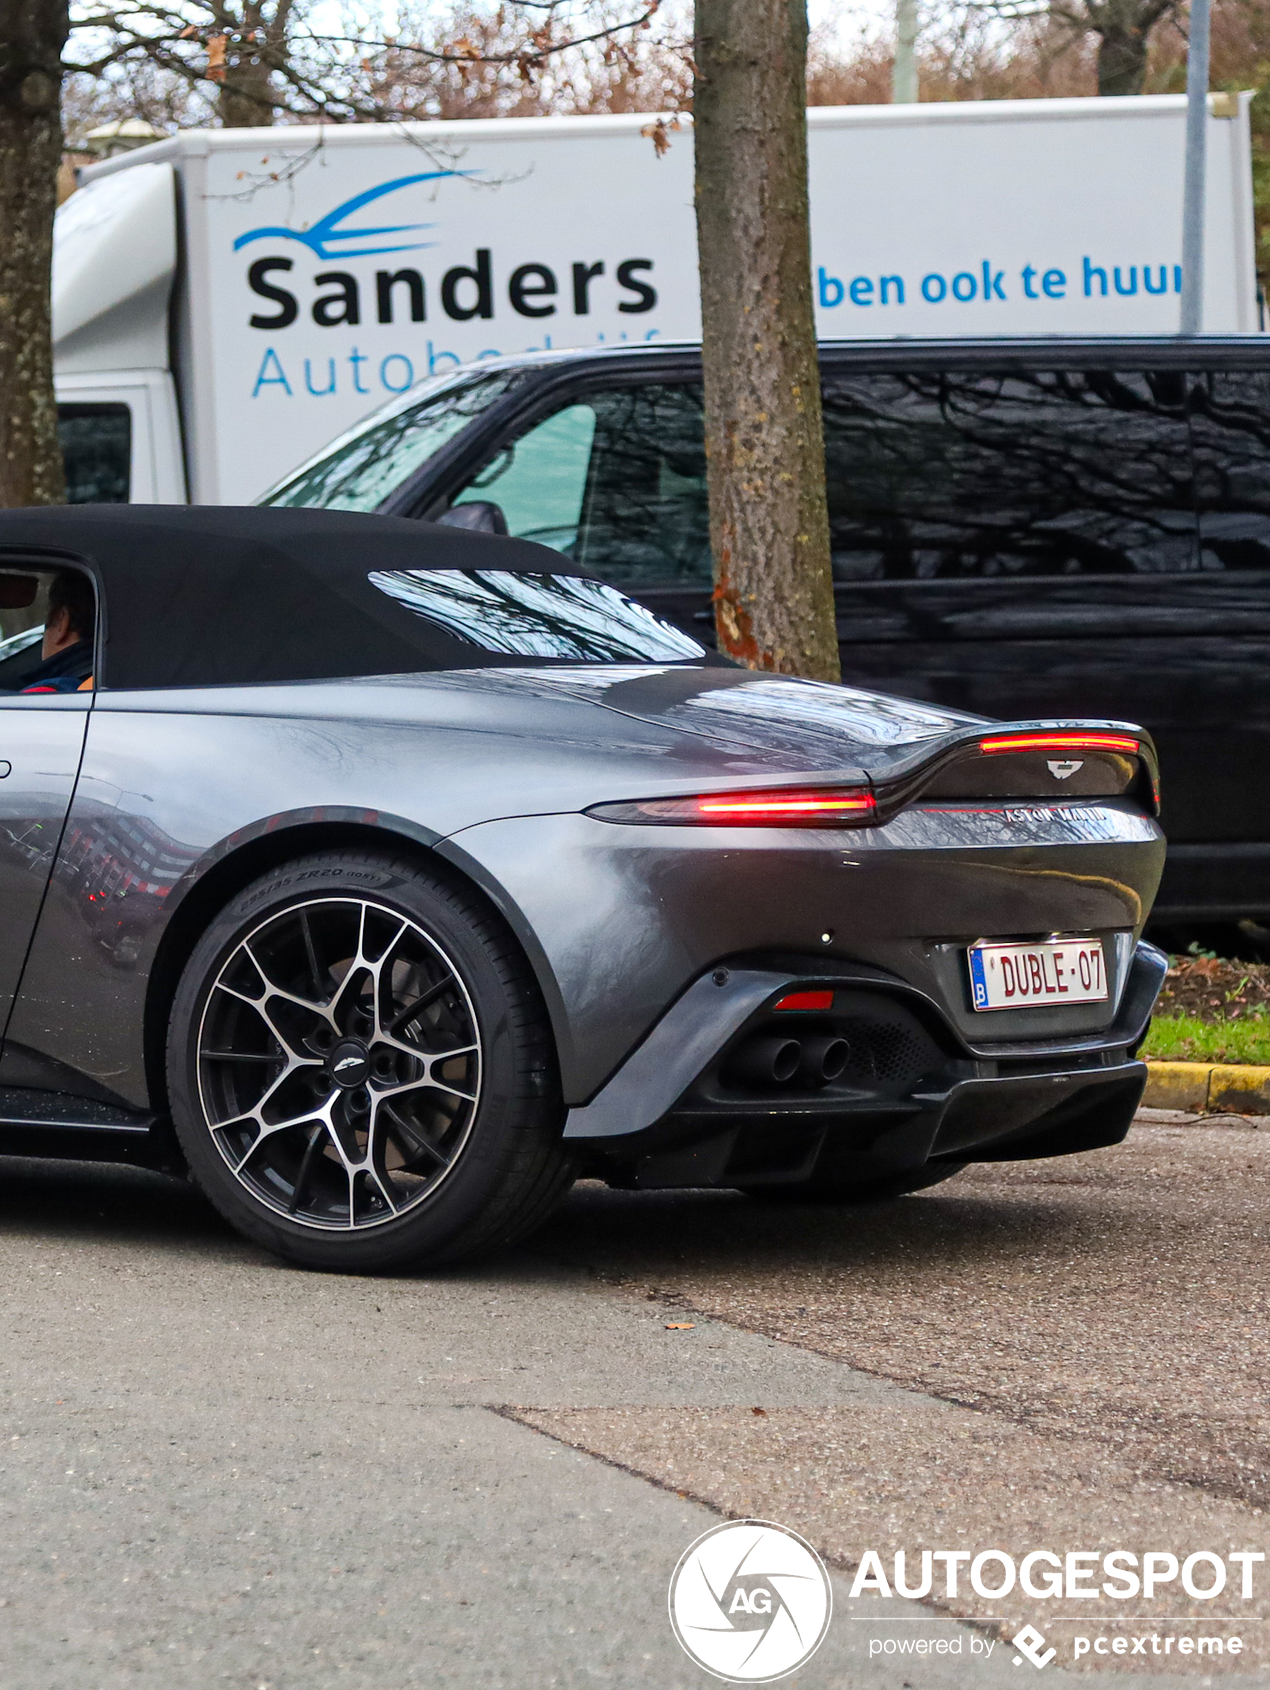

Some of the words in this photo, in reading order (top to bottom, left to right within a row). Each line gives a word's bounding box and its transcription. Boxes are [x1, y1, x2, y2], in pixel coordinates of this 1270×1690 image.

[247, 248, 657, 330] Sanders
[920, 258, 1009, 305] ook
[1020, 263, 1068, 301] te
[1006, 808, 1054, 823] ASTON
[296, 867, 343, 882] ZR20
[975, 983, 987, 1003] B
